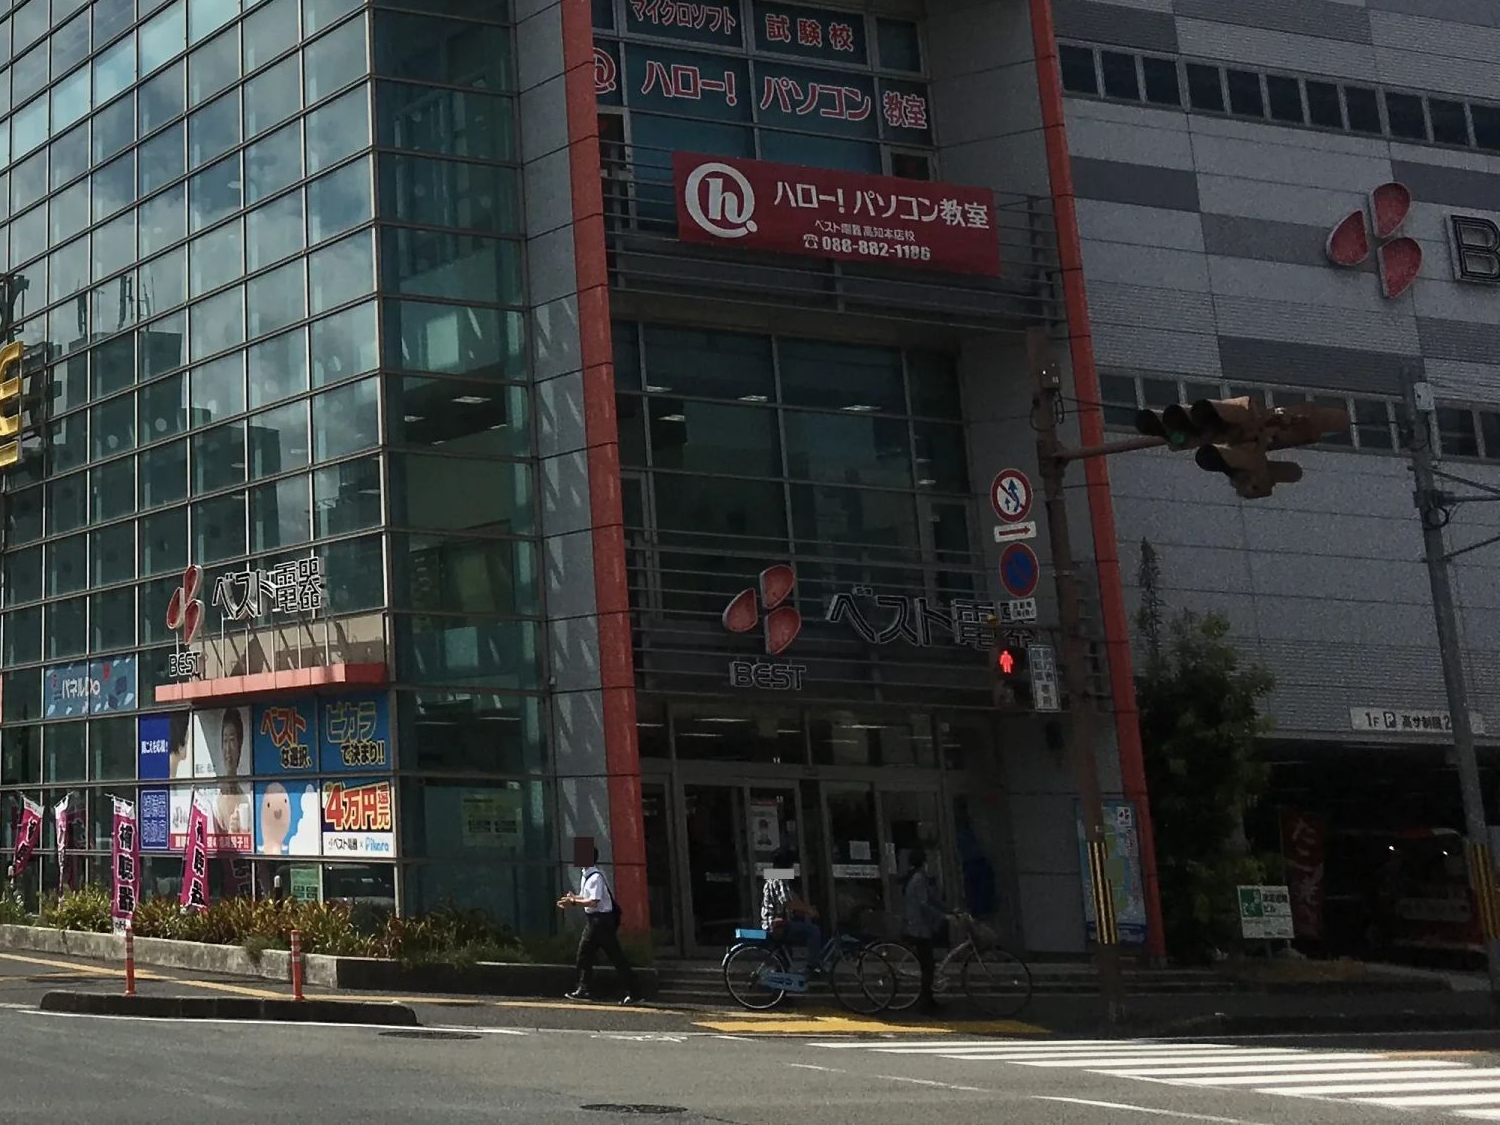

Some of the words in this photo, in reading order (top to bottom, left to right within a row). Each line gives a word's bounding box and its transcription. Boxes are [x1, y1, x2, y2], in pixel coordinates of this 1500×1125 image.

[765, 13, 854, 52] 試験校
[760, 76, 872, 121] パソコン
[883, 90, 928, 130] 教室
[212, 557, 323, 621] ベスト電器
[168, 651, 202, 677] BEST
[729, 660, 806, 691] BEST
[260, 706, 306, 747] ベスト
